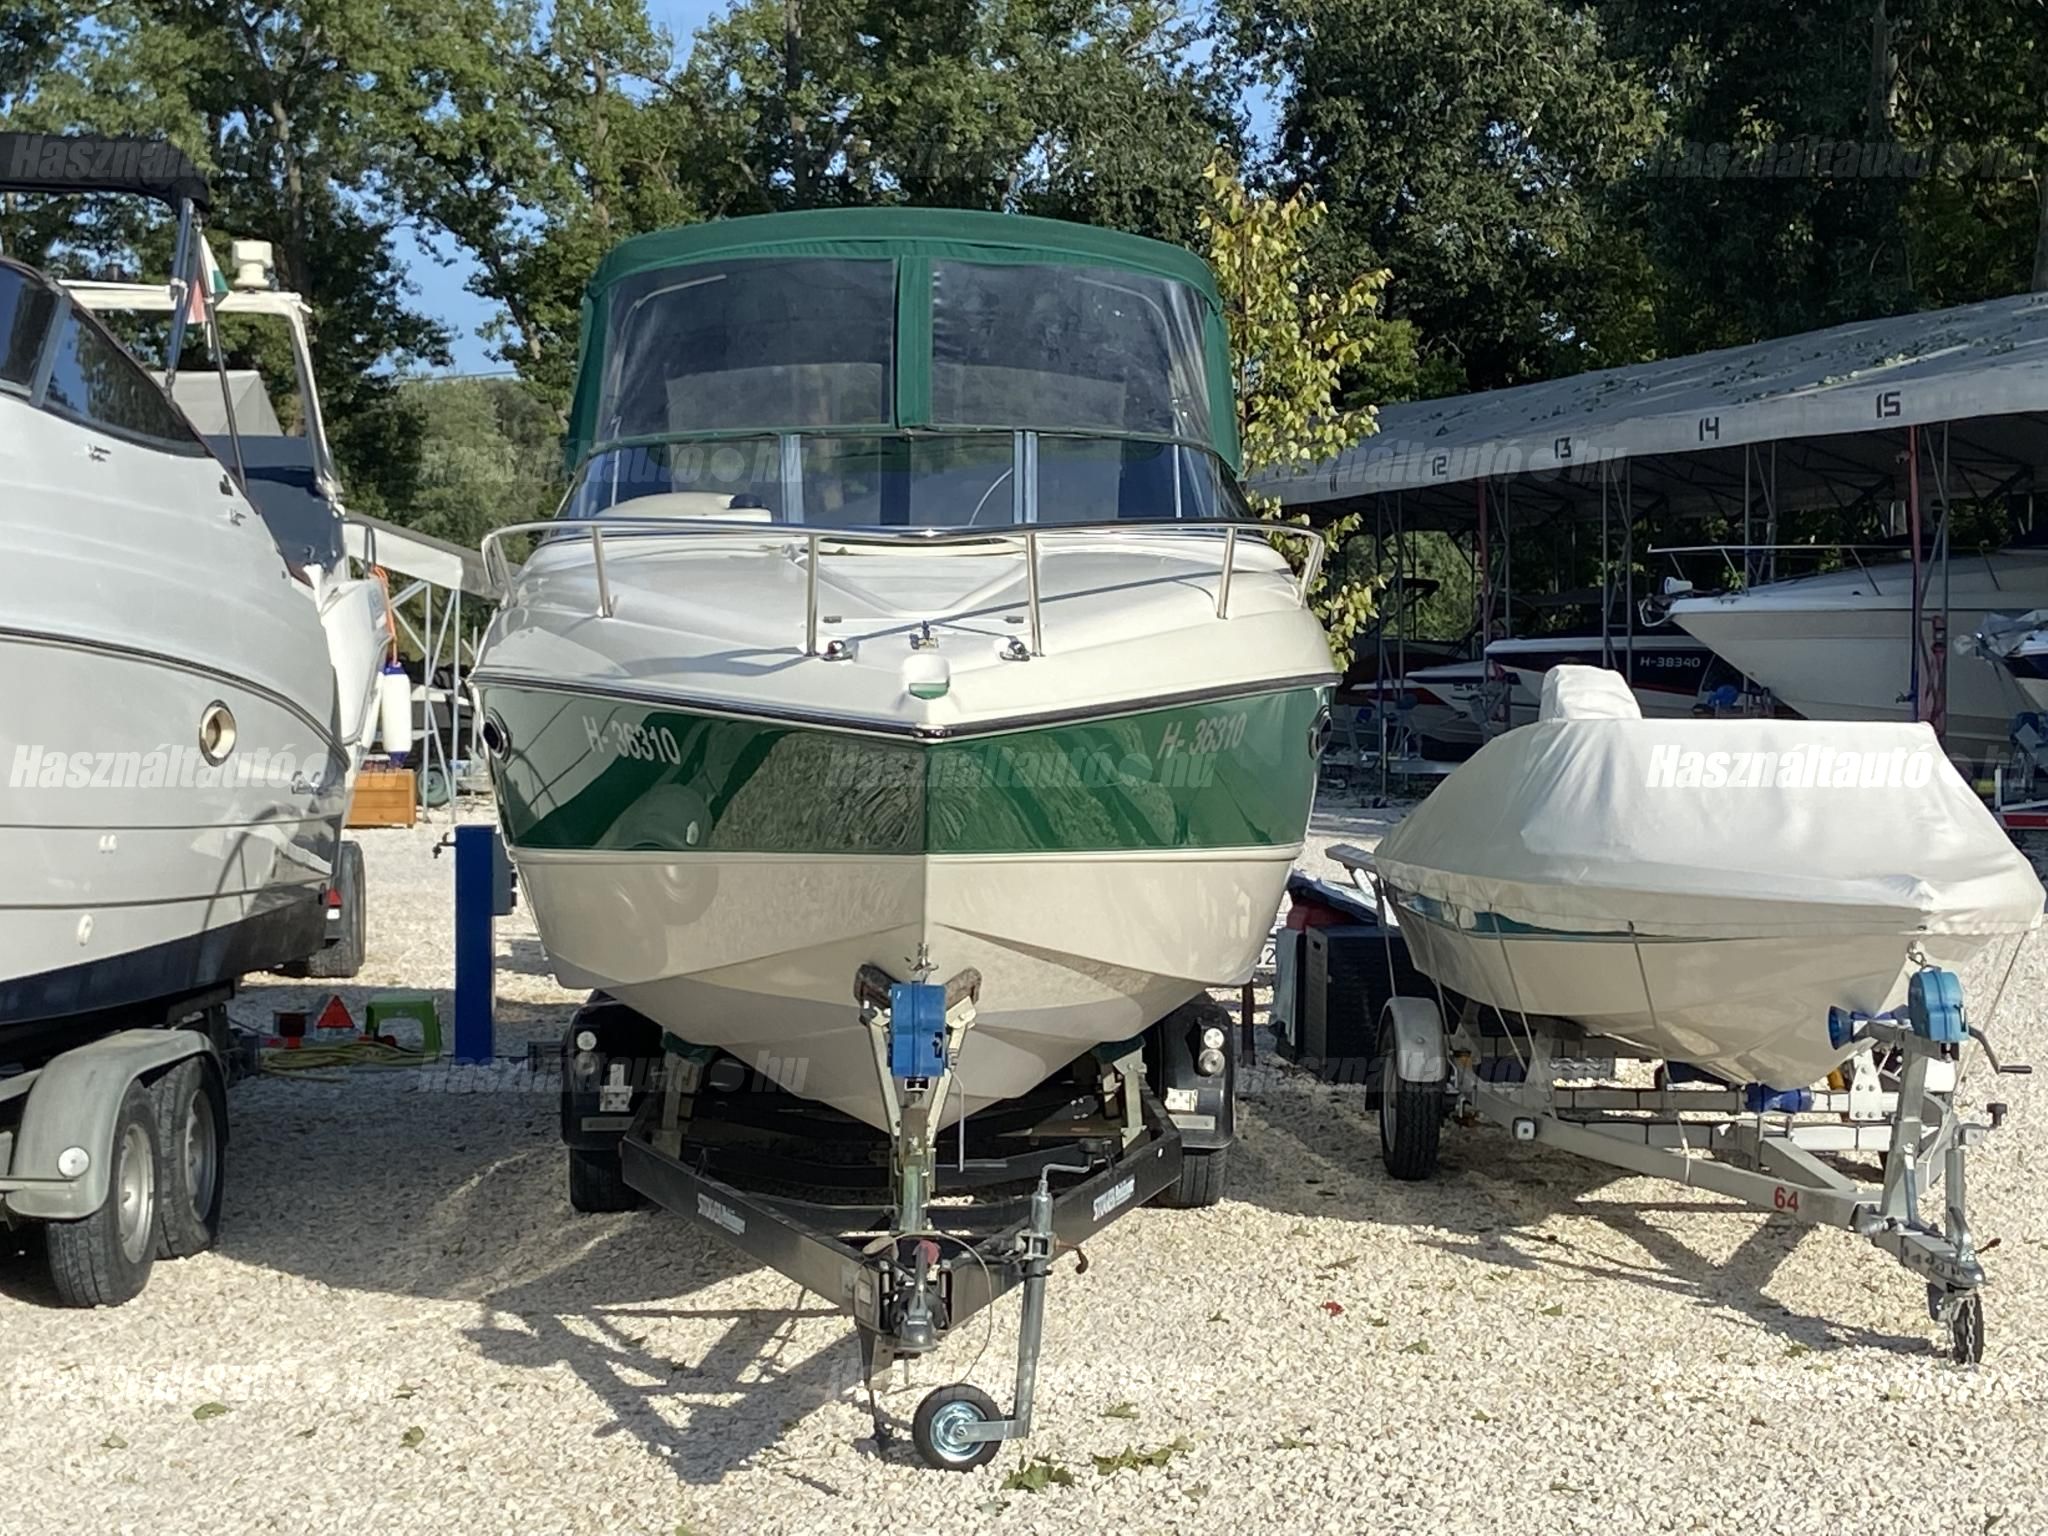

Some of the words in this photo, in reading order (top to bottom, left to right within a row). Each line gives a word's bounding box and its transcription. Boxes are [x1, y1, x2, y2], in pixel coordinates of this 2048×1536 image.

[1876, 392, 1901, 418] 15
[1699, 416, 1720, 441] 14
[1554, 437, 1573, 459] 13
[1431, 456, 1448, 476] 12
[1639, 656, 1701, 668] H-38340
[1773, 1186, 1800, 1213] 64
